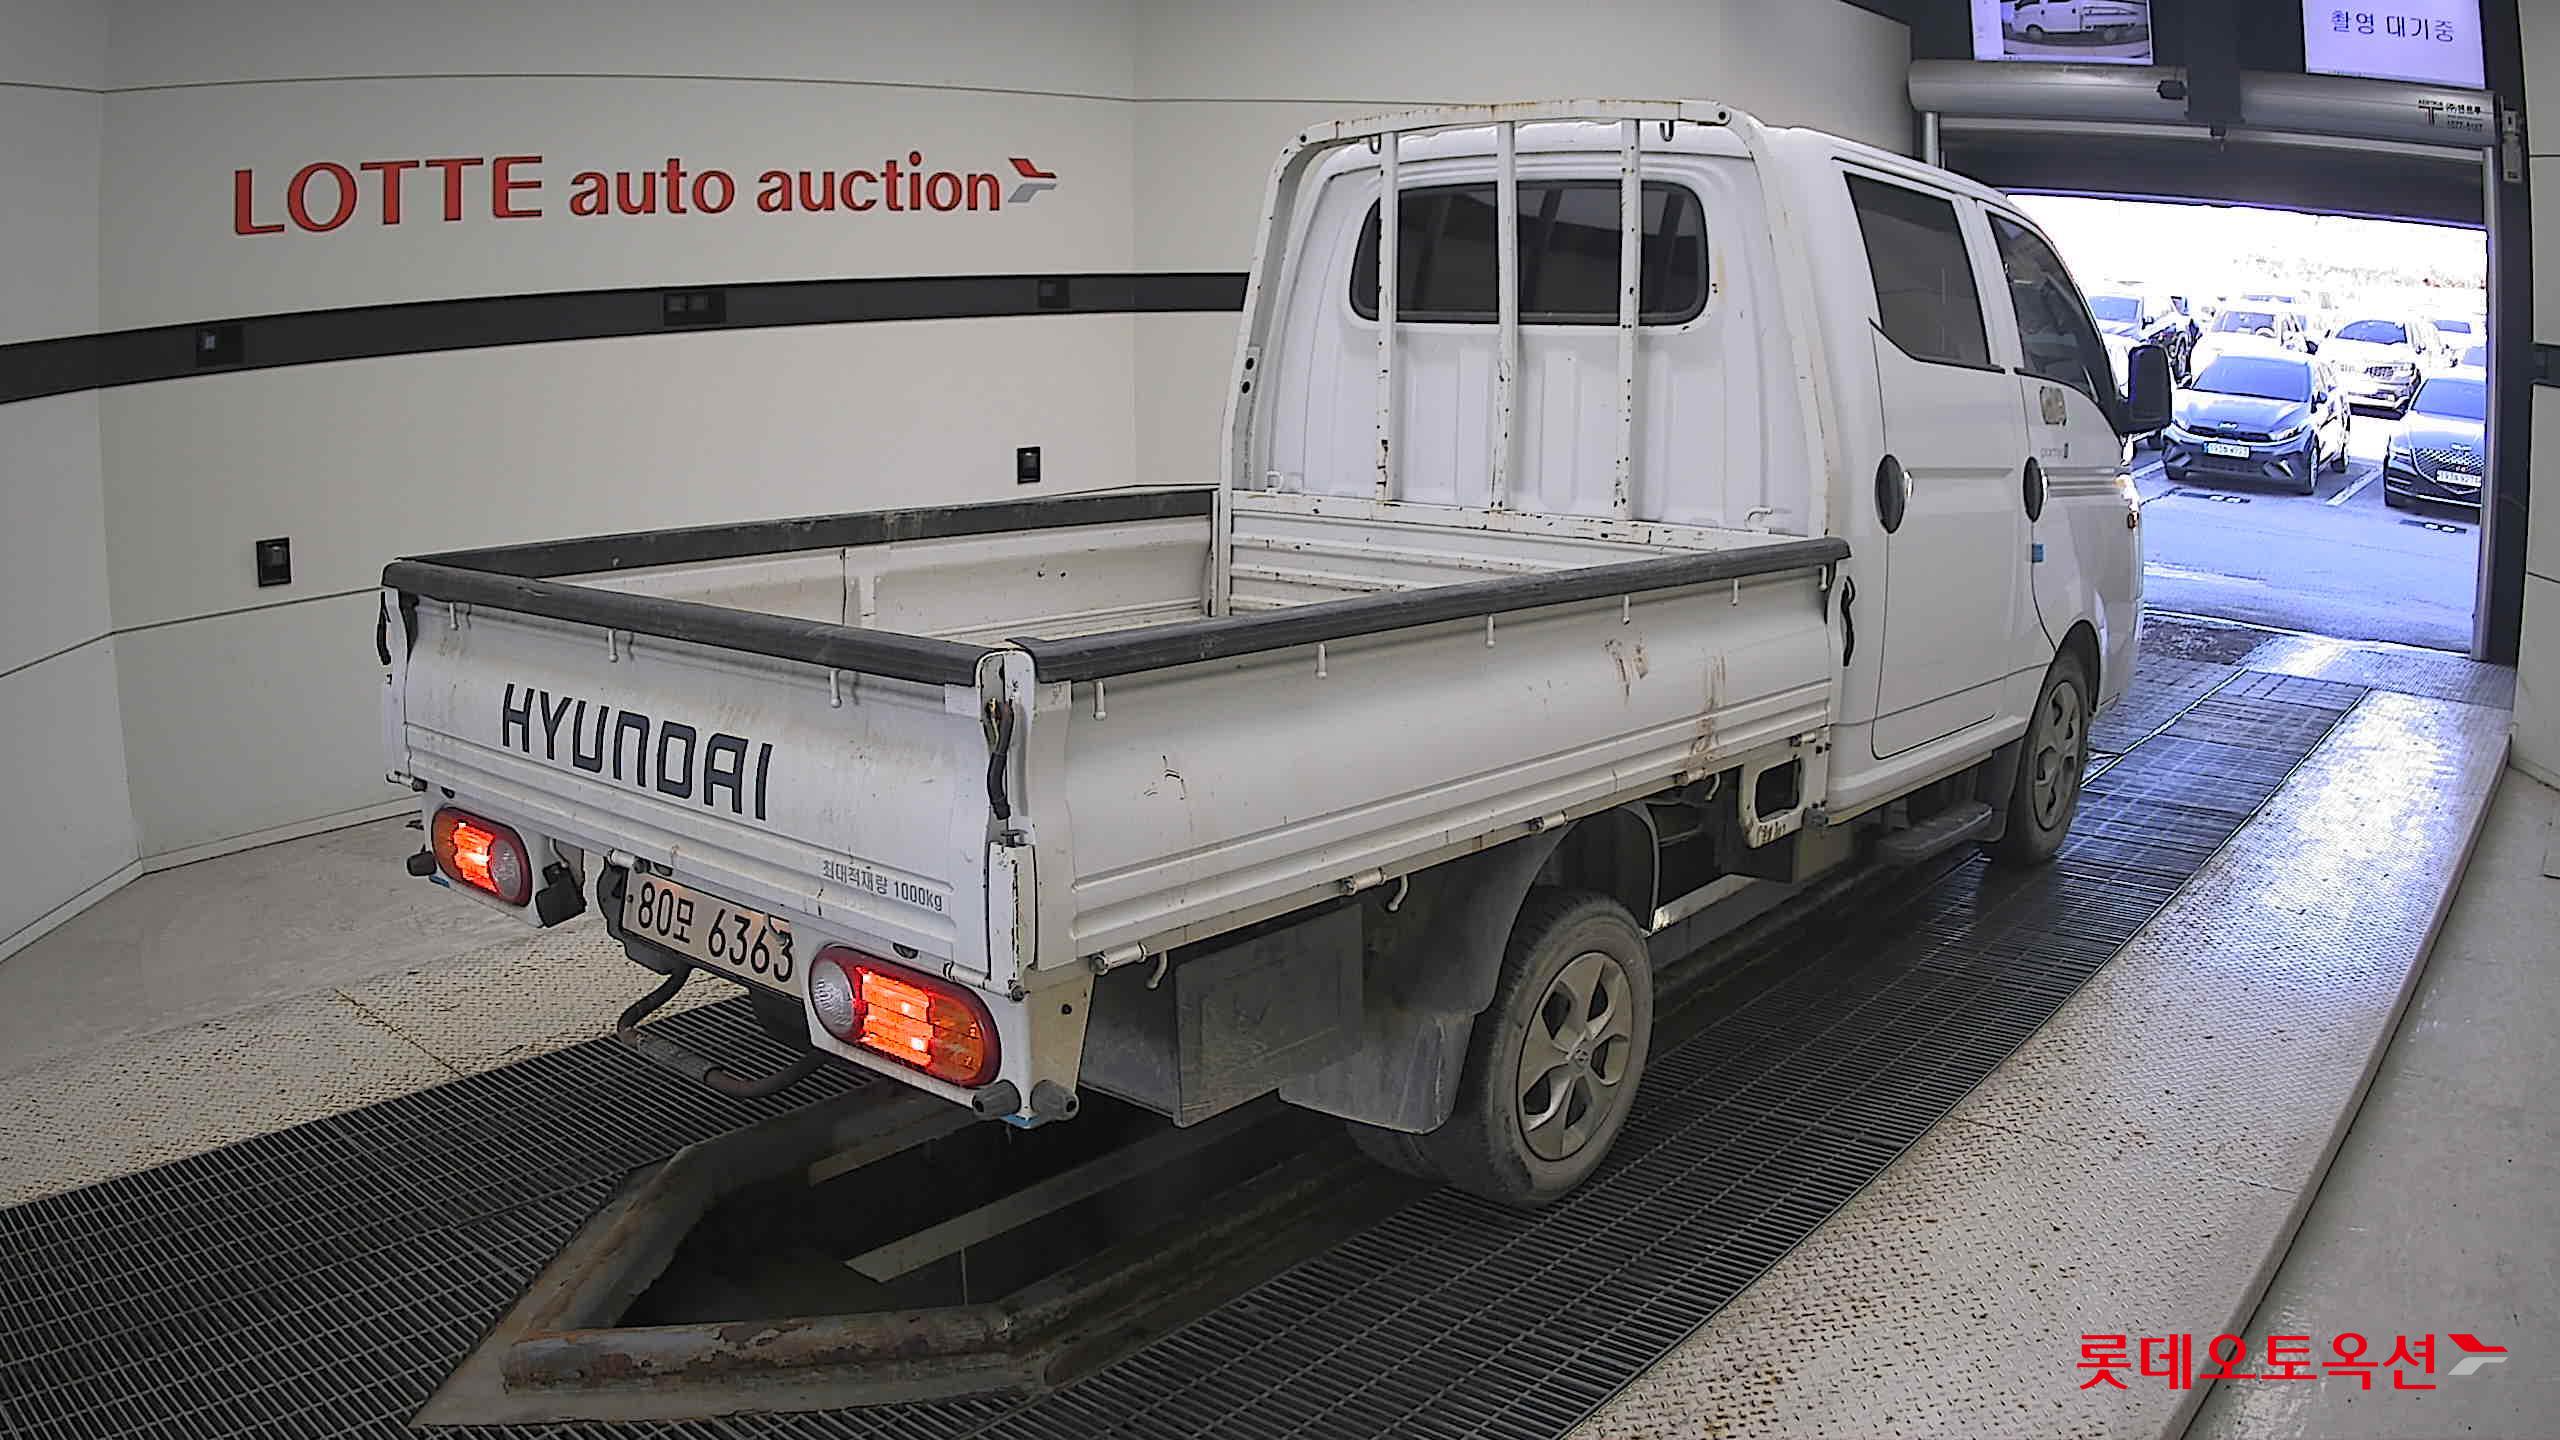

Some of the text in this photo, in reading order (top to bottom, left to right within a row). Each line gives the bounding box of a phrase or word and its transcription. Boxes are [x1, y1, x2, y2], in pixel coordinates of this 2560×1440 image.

[2331, 10, 2375, 35] 촬영
[234, 151, 1001, 235] LOTTE auto auction
[502, 683, 774, 821] HYUNDAI
[822, 859, 888, 895] 최대적재량
[637, 881, 794, 983] 80모 6363
